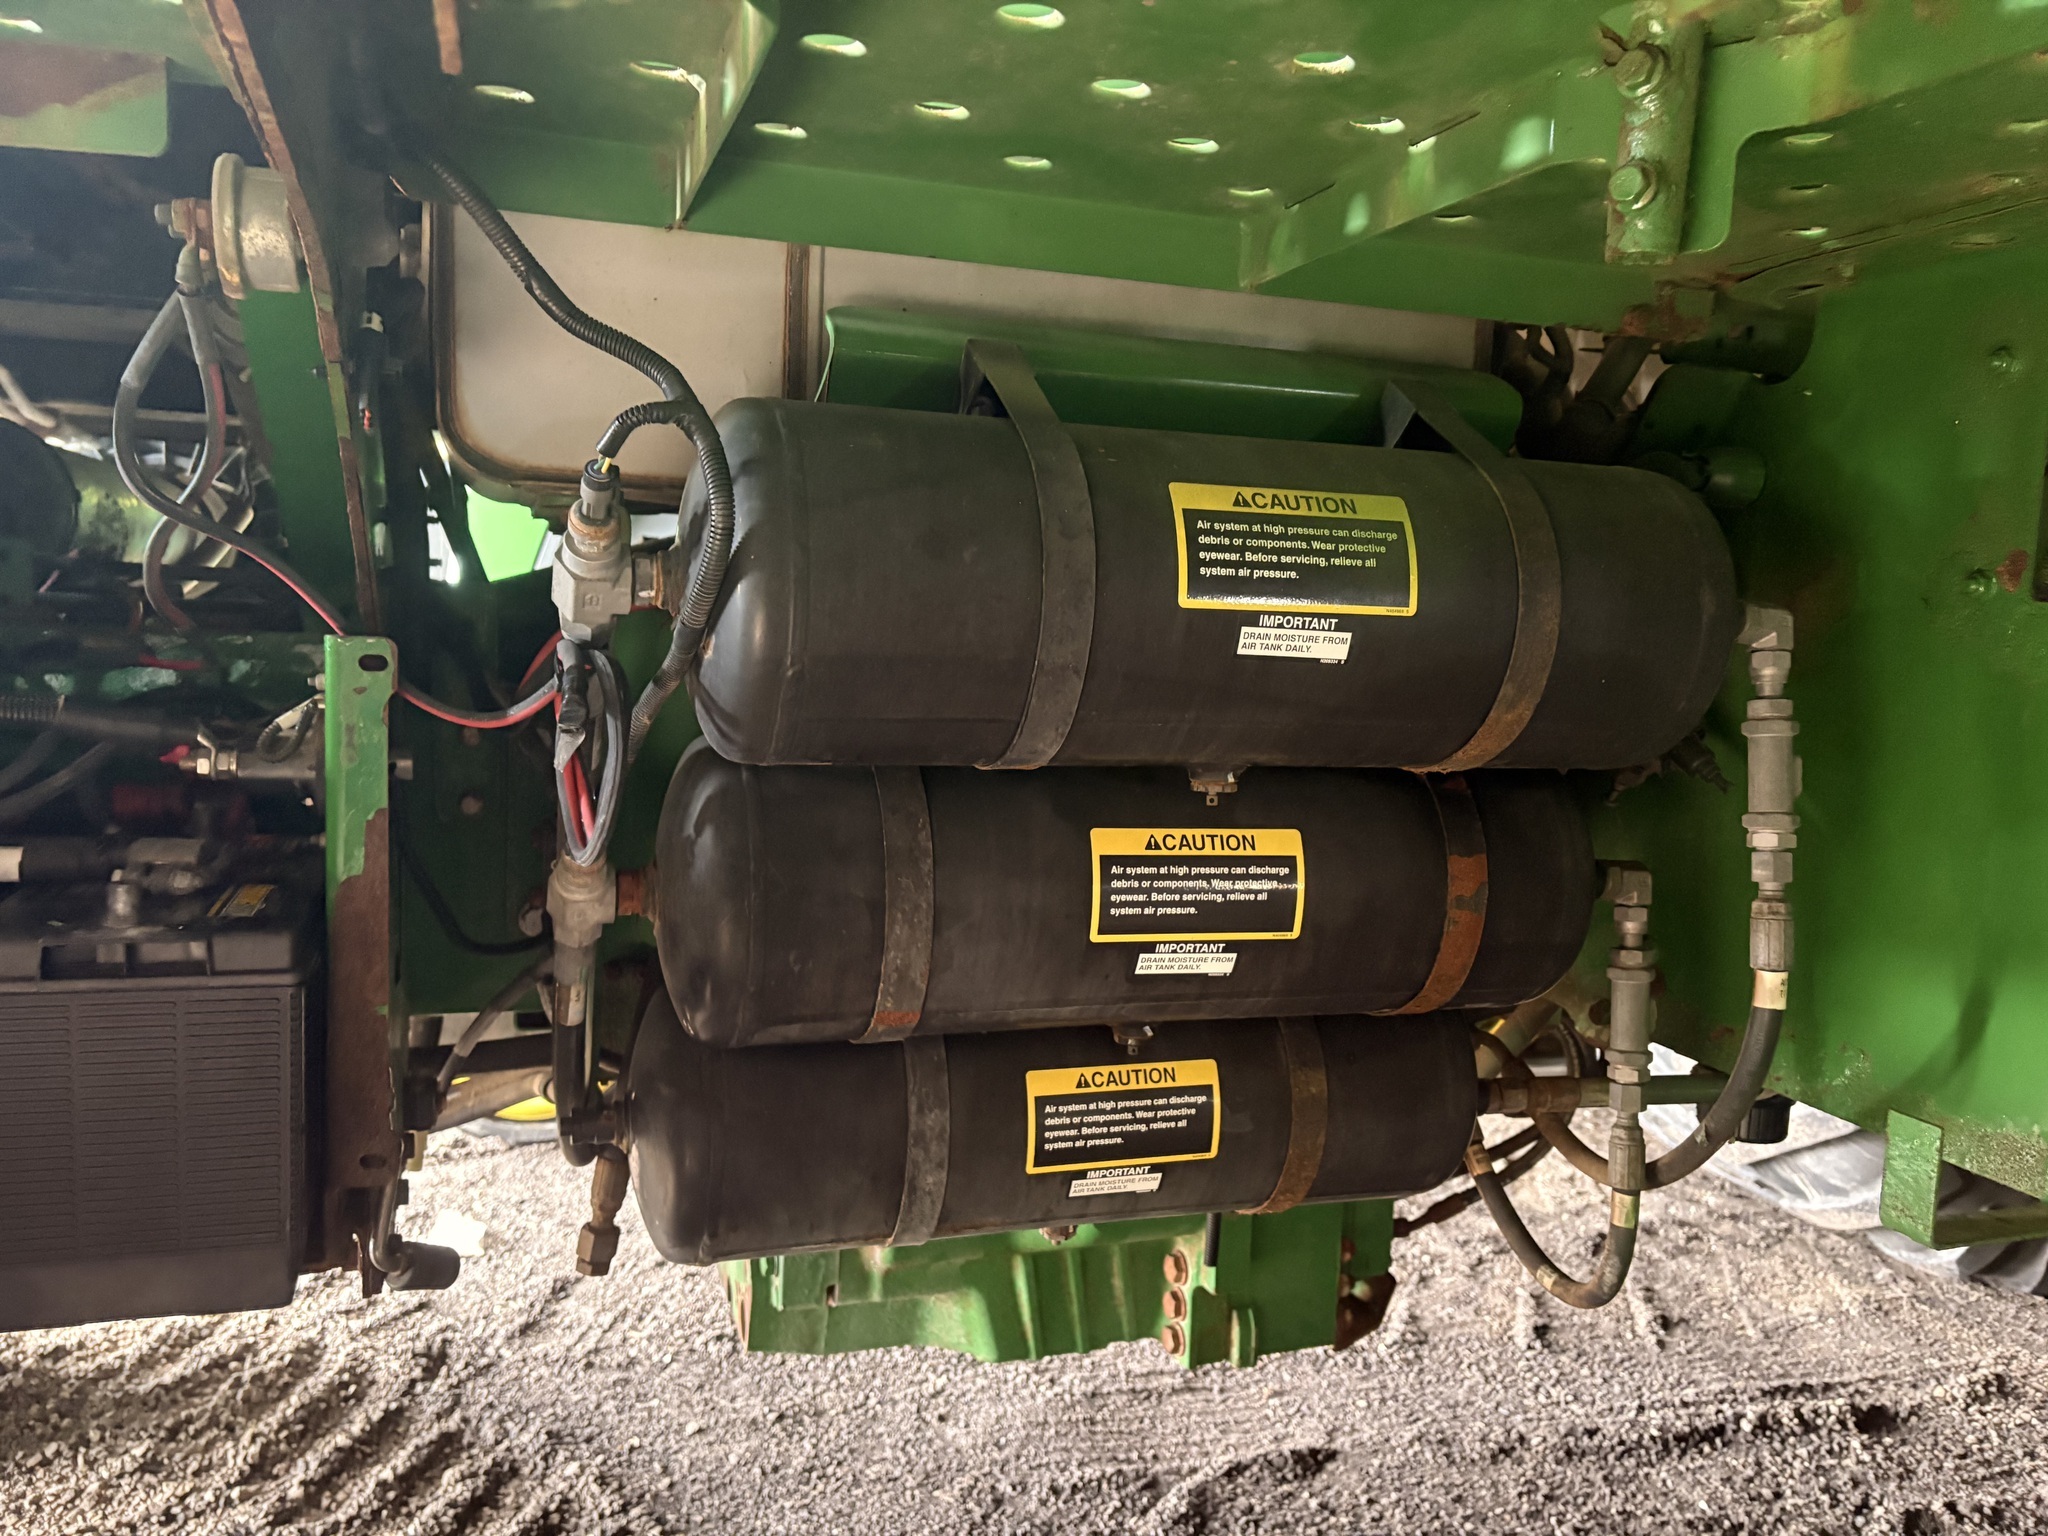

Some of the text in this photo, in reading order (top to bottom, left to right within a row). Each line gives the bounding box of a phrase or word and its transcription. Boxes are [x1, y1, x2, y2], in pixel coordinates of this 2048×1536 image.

[1251, 492, 1357, 514] CAUTION
[1197, 520, 1398, 540] Air system at high pressure can discharge
[1198, 535, 1386, 553] debris or components. Wear protective
[1199, 552, 1376, 567] eyewear. Before servicing, relieve all
[1200, 566, 1299, 580] system air pressure.
[1259, 615, 1338, 631] IMPORTANT
[1243, 632, 1348, 645] DRAIN MOISTURE FROM
[1285, 645, 1312, 653] DAILY.
[1163, 834, 1256, 851] CAUTION
[1111, 866, 1124, 874] Air
[1126, 866, 1157, 876] system
[1170, 866, 1189, 875] high
[1191, 867, 1229, 875] pressure
[1248, 866, 1289, 875] discharge
[1111, 879, 1139, 888] debris
[1153, 880, 1209, 889] components.
[1211, 879, 1233, 888] Wear
[1235, 879, 1277, 889] protective
[1111, 894, 1149, 903] eyewear.
[1151, 893, 1180, 901] Before
[1182, 893, 1224, 902] servicing,
[1110, 906, 1141, 916] system
[1157, 907, 1198, 916] pressure.
[1155, 944, 1226, 953] IMPORTANT
[1092, 1067, 1176, 1087] CAUTION
[1045, 1105, 1056, 1113] Air
[1058, 1103, 1087, 1113] system
[1098, 1101, 1116, 1110] high
[1118, 1098, 1152, 1109] pressure
[1169, 1094, 1207, 1104] discharge
[1045, 1116, 1070, 1125] debris
[1083, 1113, 1134, 1123] components.
[1135, 1110, 1155, 1119] Wear
[1157, 1107, 1196, 1118] protective
[1045, 1128, 1079, 1138] eyewear.
[1082, 1125, 1108, 1134] Before
[1110, 1123, 1148, 1133] servicing,
[1150, 1121, 1175, 1129] relieve
[1044, 1137, 1124, 1150] system air pressure.
[1087, 1166, 1151, 1178] IMPORTANT
[1098, 1178, 1136, 1186] MOISTURE
